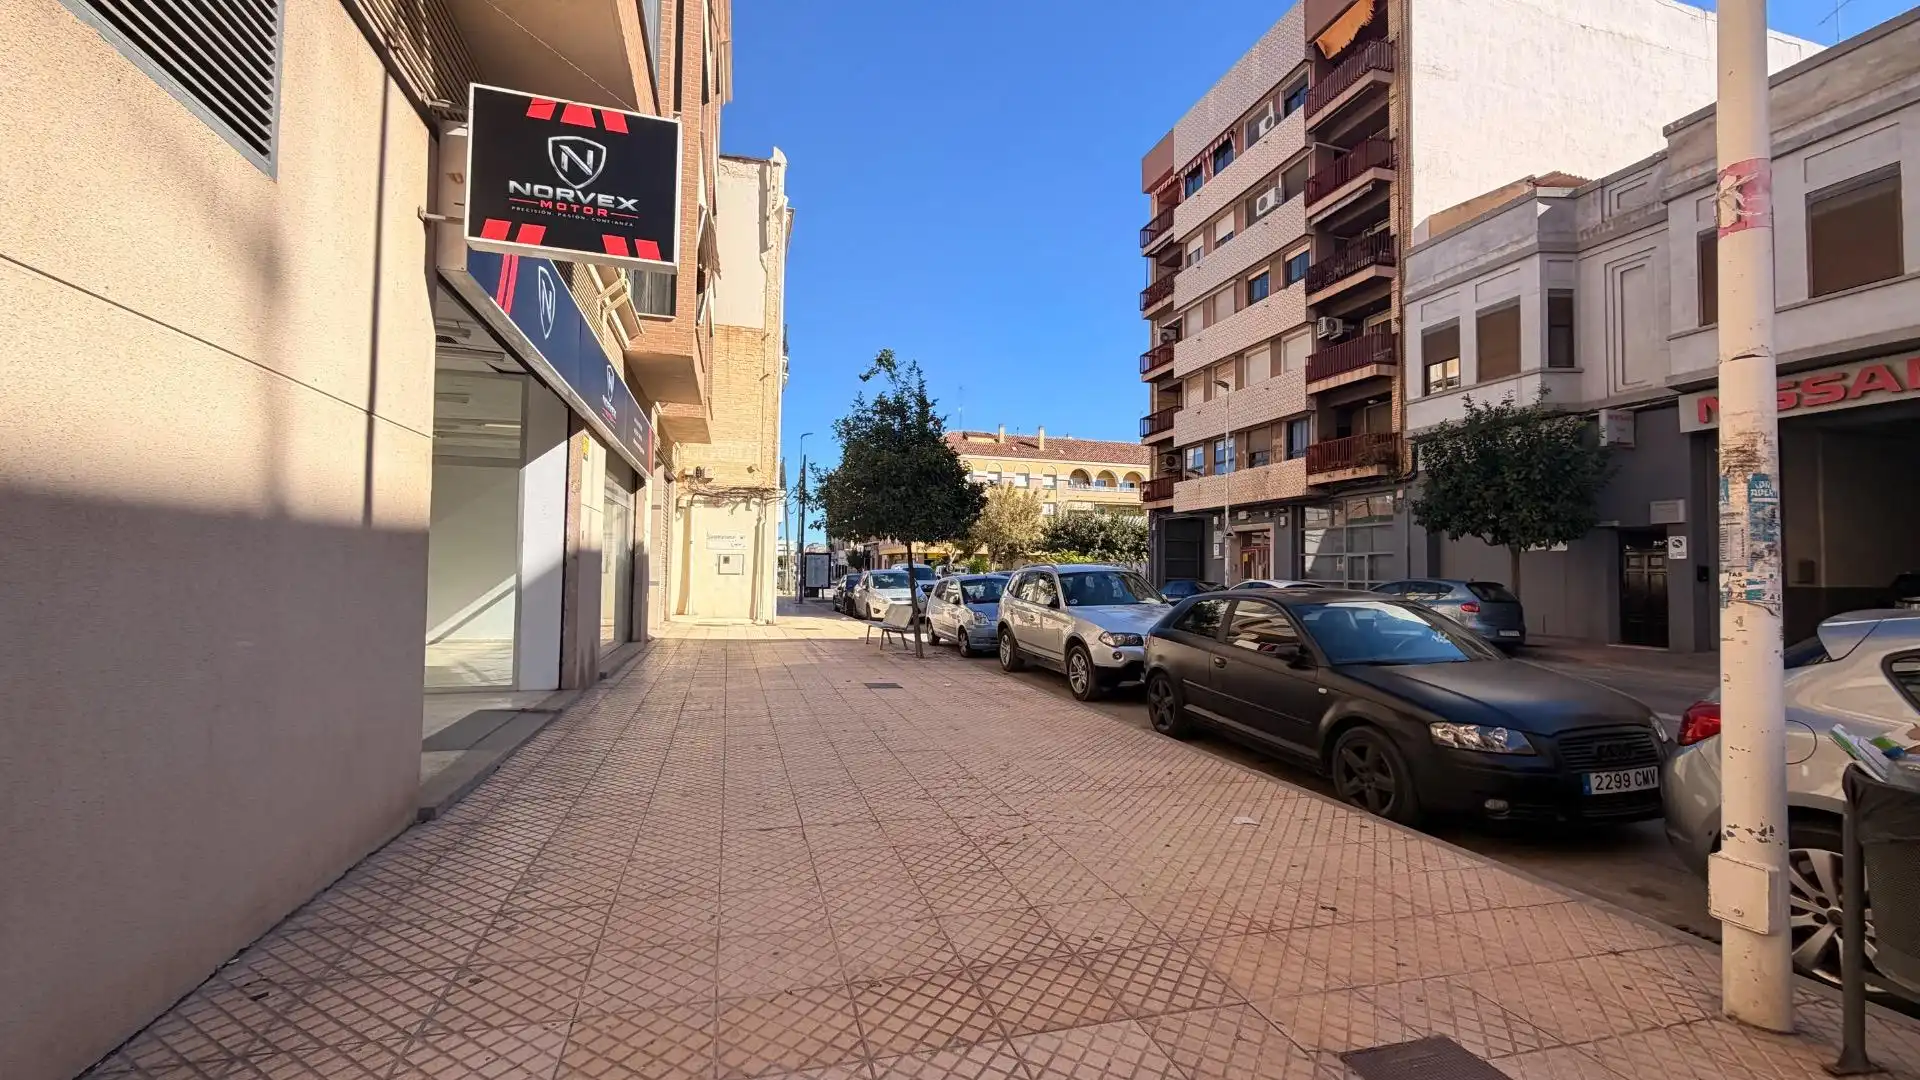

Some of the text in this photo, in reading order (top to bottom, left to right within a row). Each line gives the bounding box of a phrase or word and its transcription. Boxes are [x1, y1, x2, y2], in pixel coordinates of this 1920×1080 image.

[508, 179, 640, 212] NORVEX
[540, 199, 609, 217] MOTOR
[1696, 355, 1920, 425] NSSA
[1594, 768, 1656, 791] 2299 CMV
